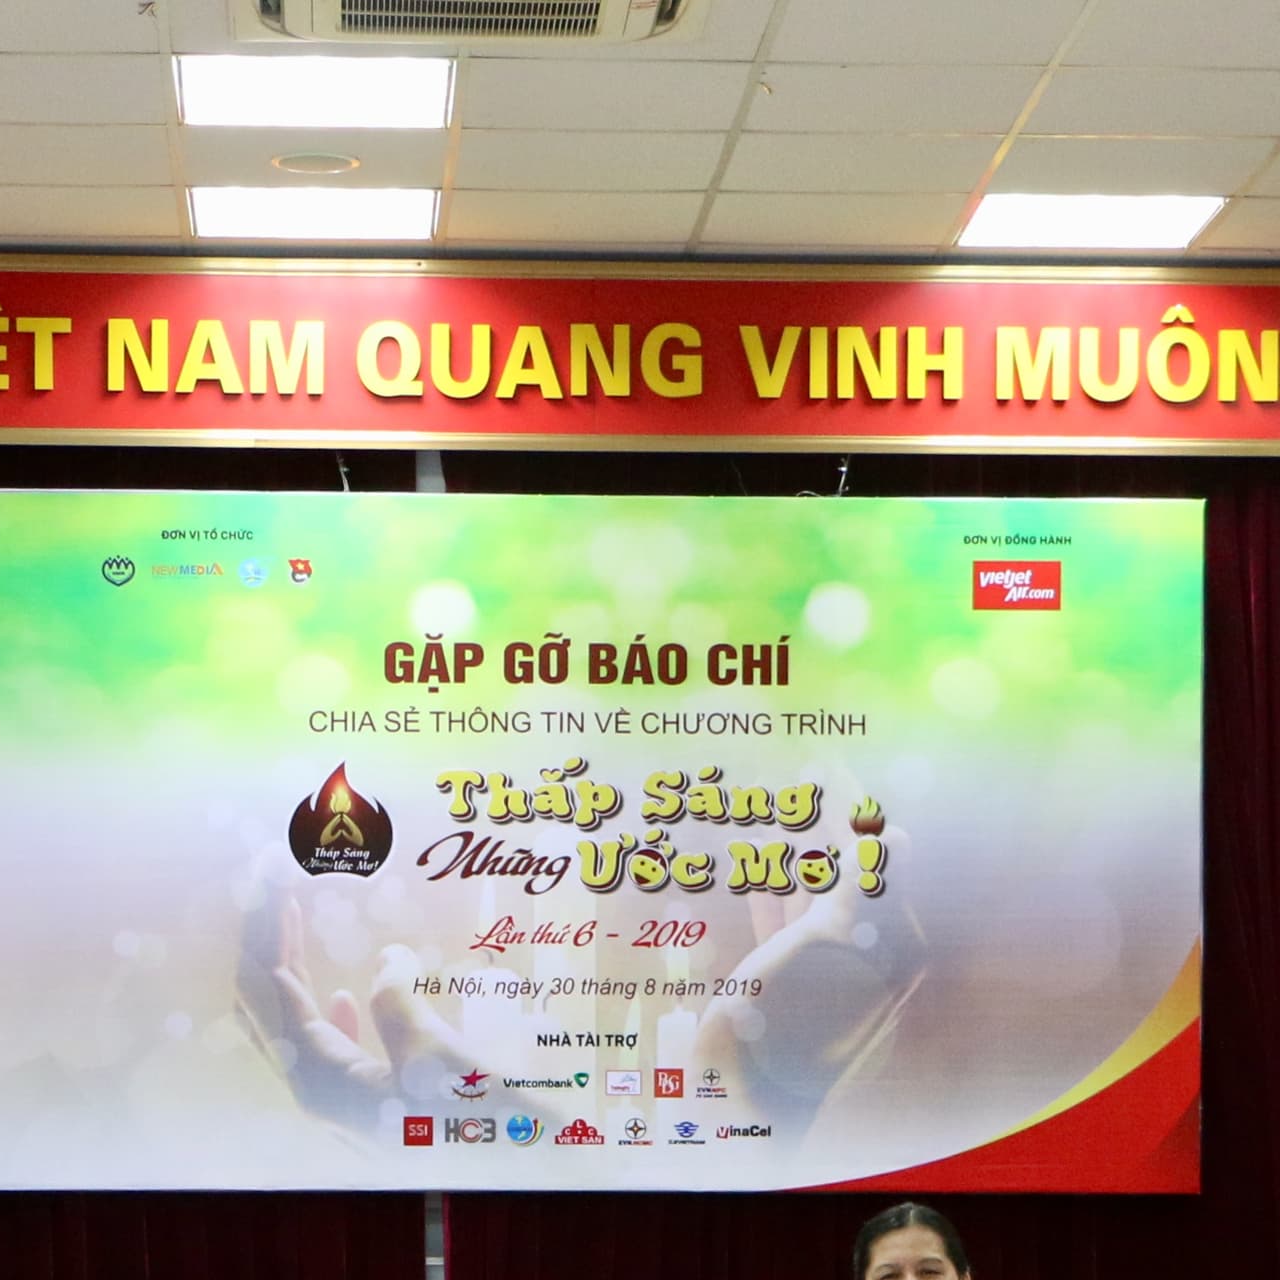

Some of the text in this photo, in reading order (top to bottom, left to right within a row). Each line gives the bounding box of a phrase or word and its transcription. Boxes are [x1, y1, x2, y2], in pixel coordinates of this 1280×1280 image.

[107, 317, 325, 397] NAM
[355, 320, 704, 402] QUANG
[738, 324, 965, 404] VINH
[161, 530, 186, 540] ĐƠN
[189, 530, 200, 542] VỊ
[221, 529, 254, 540] CHỨC
[963, 535, 987, 545] ĐƠN
[990, 536, 1001, 547] VỊ
[1040, 535, 1072, 545] HÀNH
[384, 632, 791, 693] GẶP GỠ BÁO CHÍ
[309, 706, 867, 736] CHIA SẺ THÔNG TIN VỀ CHƯƠNG TRÌNH
[435, 756, 824, 831] Thắp Sáng
[415, 831, 571, 896] Những
[469, 915, 526, 952] Lần
[530, 921, 571, 945] thứ
[572, 920, 597, 947] 6
[631, 920, 707, 948] 2019
[412, 977, 762, 1000] Hà Nội, ngày 30 tháng 8 năm 2019
[537, 1032, 638, 1049] NHÀ TÀI TRỢ
[503, 1078, 573, 1088] Vietcombank
[408, 1124, 428, 1136] SSI
